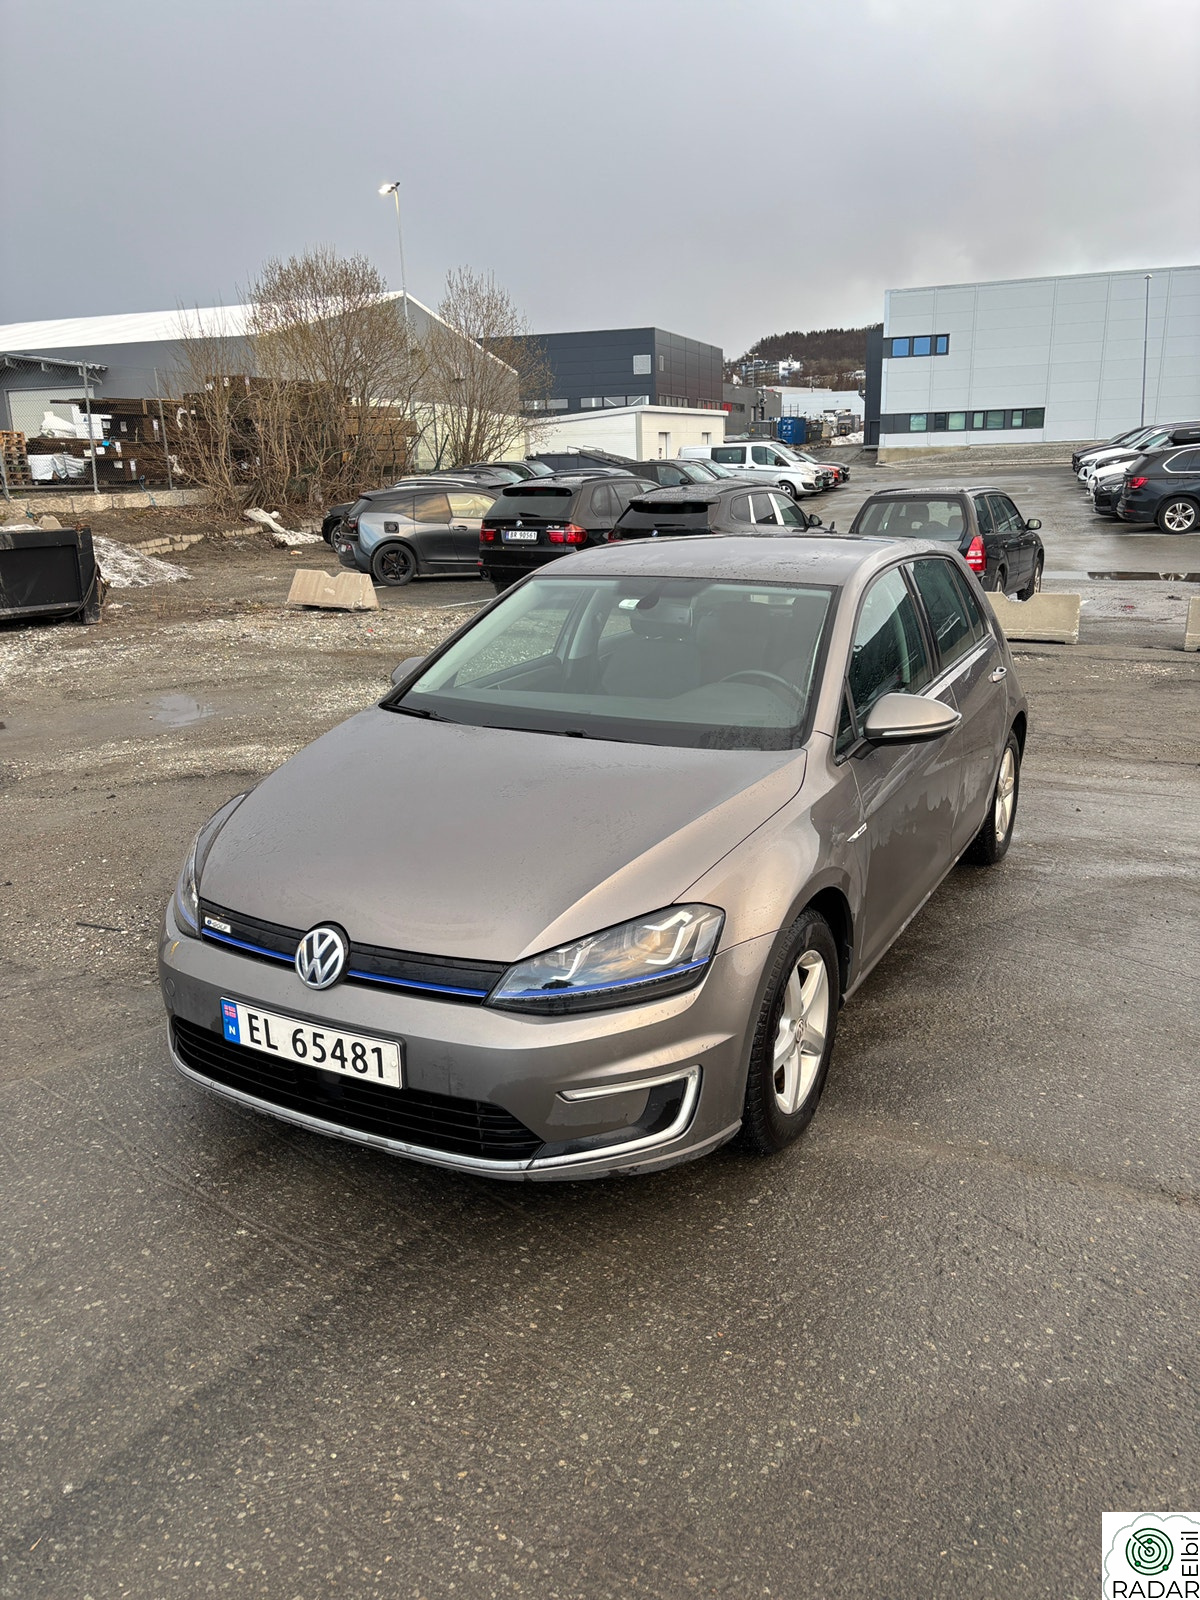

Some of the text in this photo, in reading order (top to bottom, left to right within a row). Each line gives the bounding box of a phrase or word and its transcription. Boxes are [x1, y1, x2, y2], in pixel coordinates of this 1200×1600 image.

[228, 1024, 236, 1035] N
[247, 1012, 384, 1078] EL 65481
